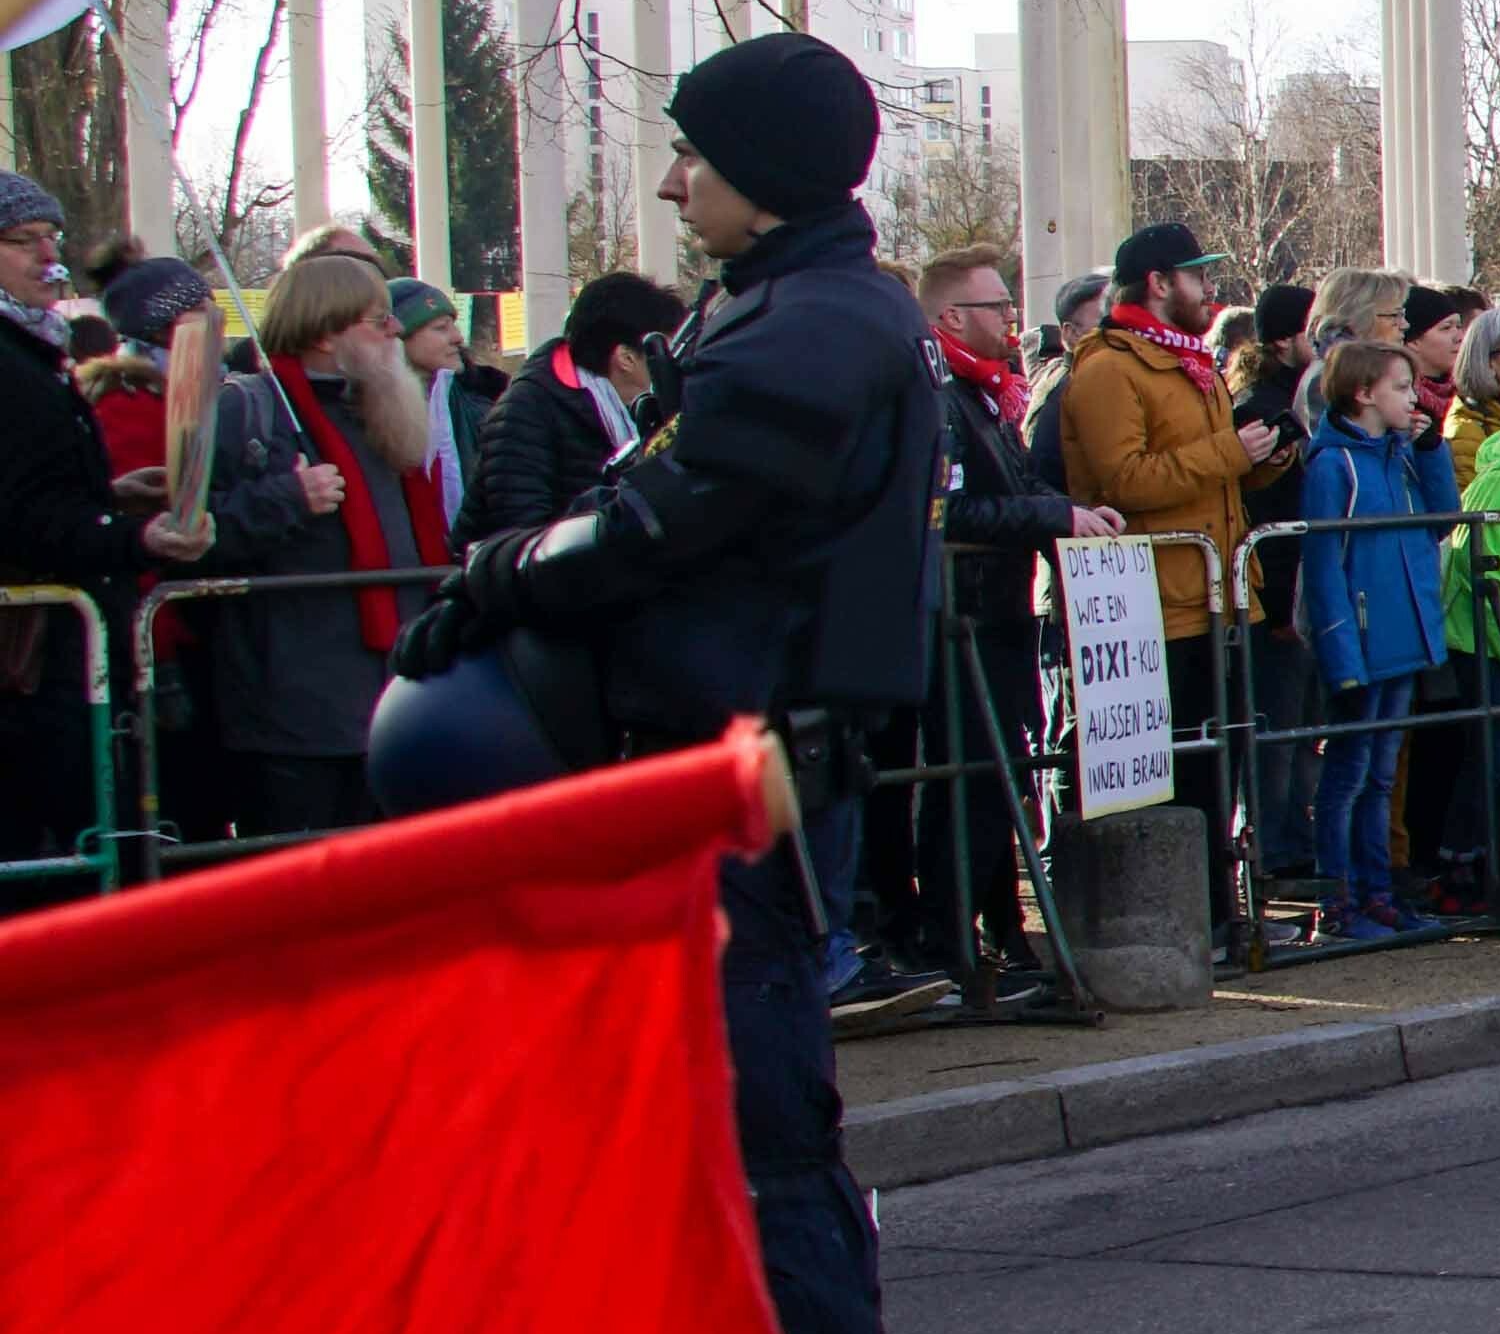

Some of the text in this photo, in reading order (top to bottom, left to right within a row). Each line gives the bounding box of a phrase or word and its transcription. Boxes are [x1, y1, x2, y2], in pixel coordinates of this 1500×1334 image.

[1067, 542, 1151, 578] DIE AfD IST
[1075, 594, 1128, 625] WIE EIN
[1087, 697, 1169, 746] AUSSEN BLAU
[1089, 750, 1170, 795] INNEN BRAUN
